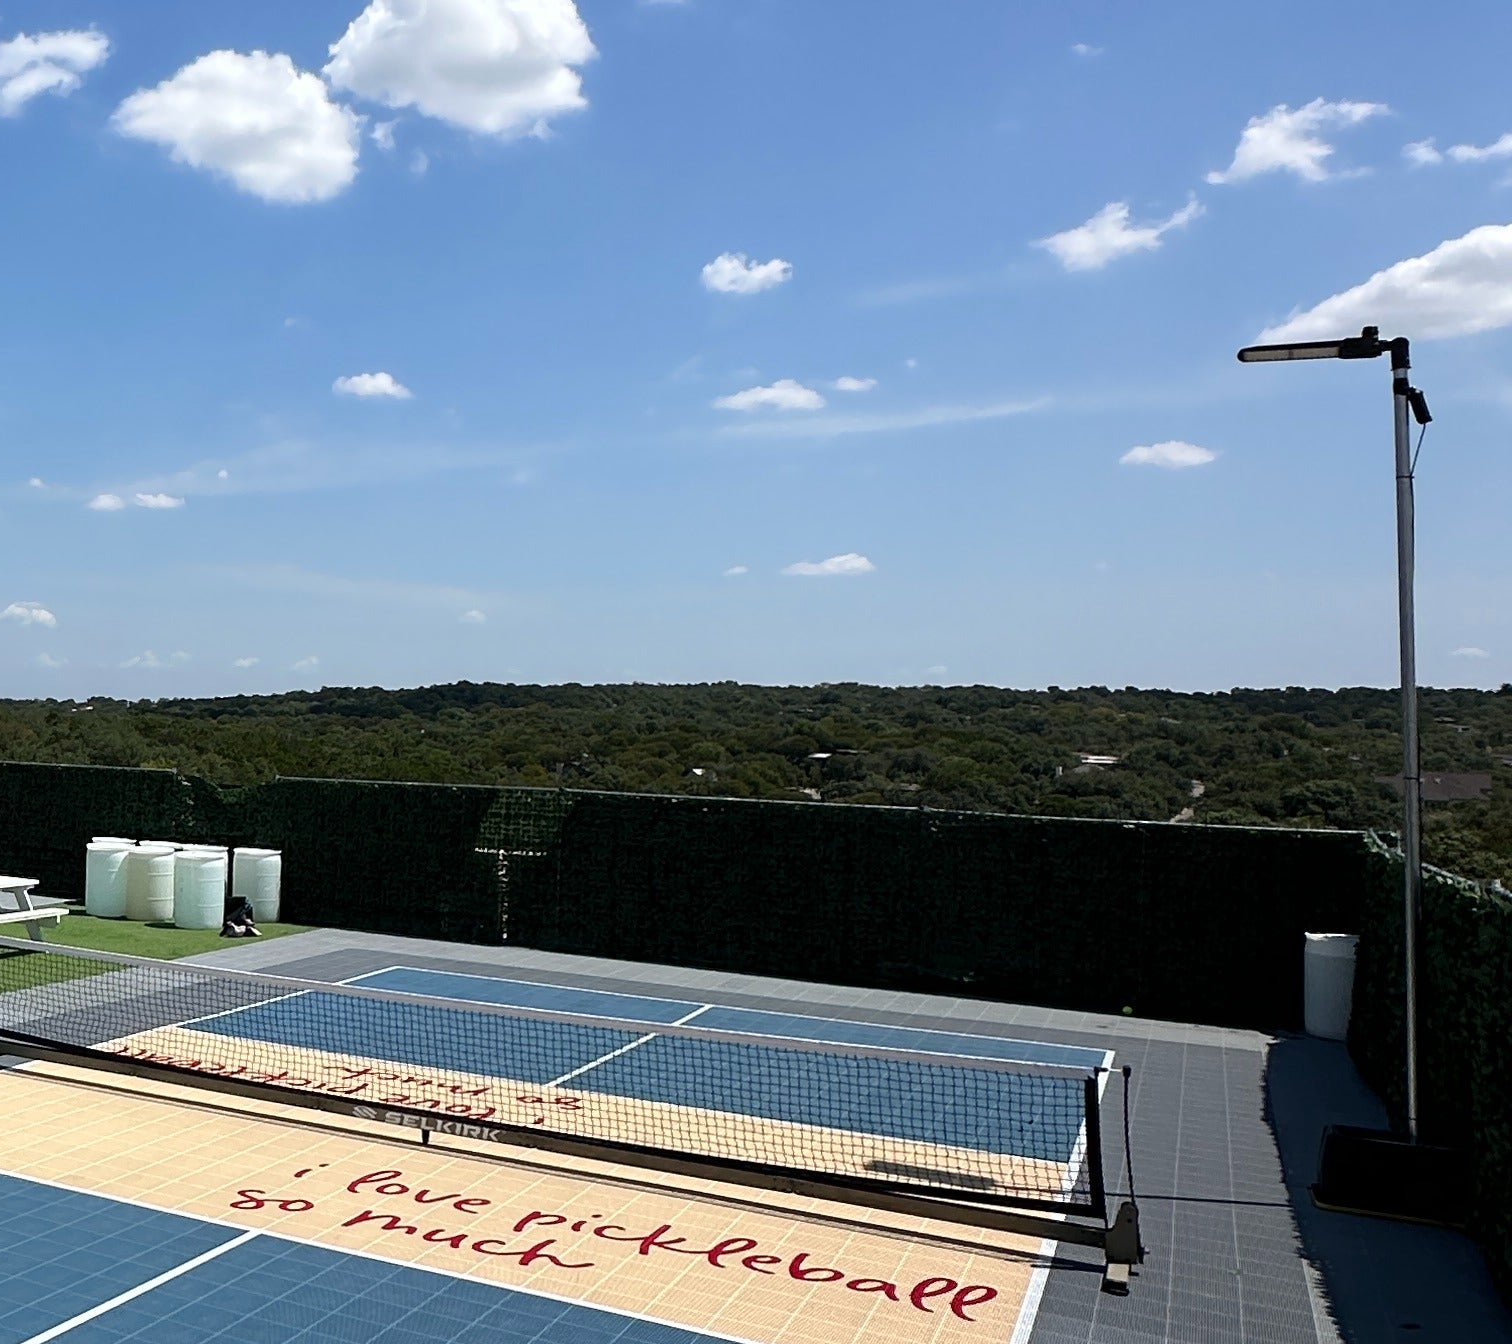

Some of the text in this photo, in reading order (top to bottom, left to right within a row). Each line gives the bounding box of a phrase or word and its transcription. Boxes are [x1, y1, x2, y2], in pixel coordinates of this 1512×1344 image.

[384, 1111, 502, 1142] SELKIRK
[229, 1188, 595, 1268] so much
[293, 1162, 998, 1322] i love pickleball
